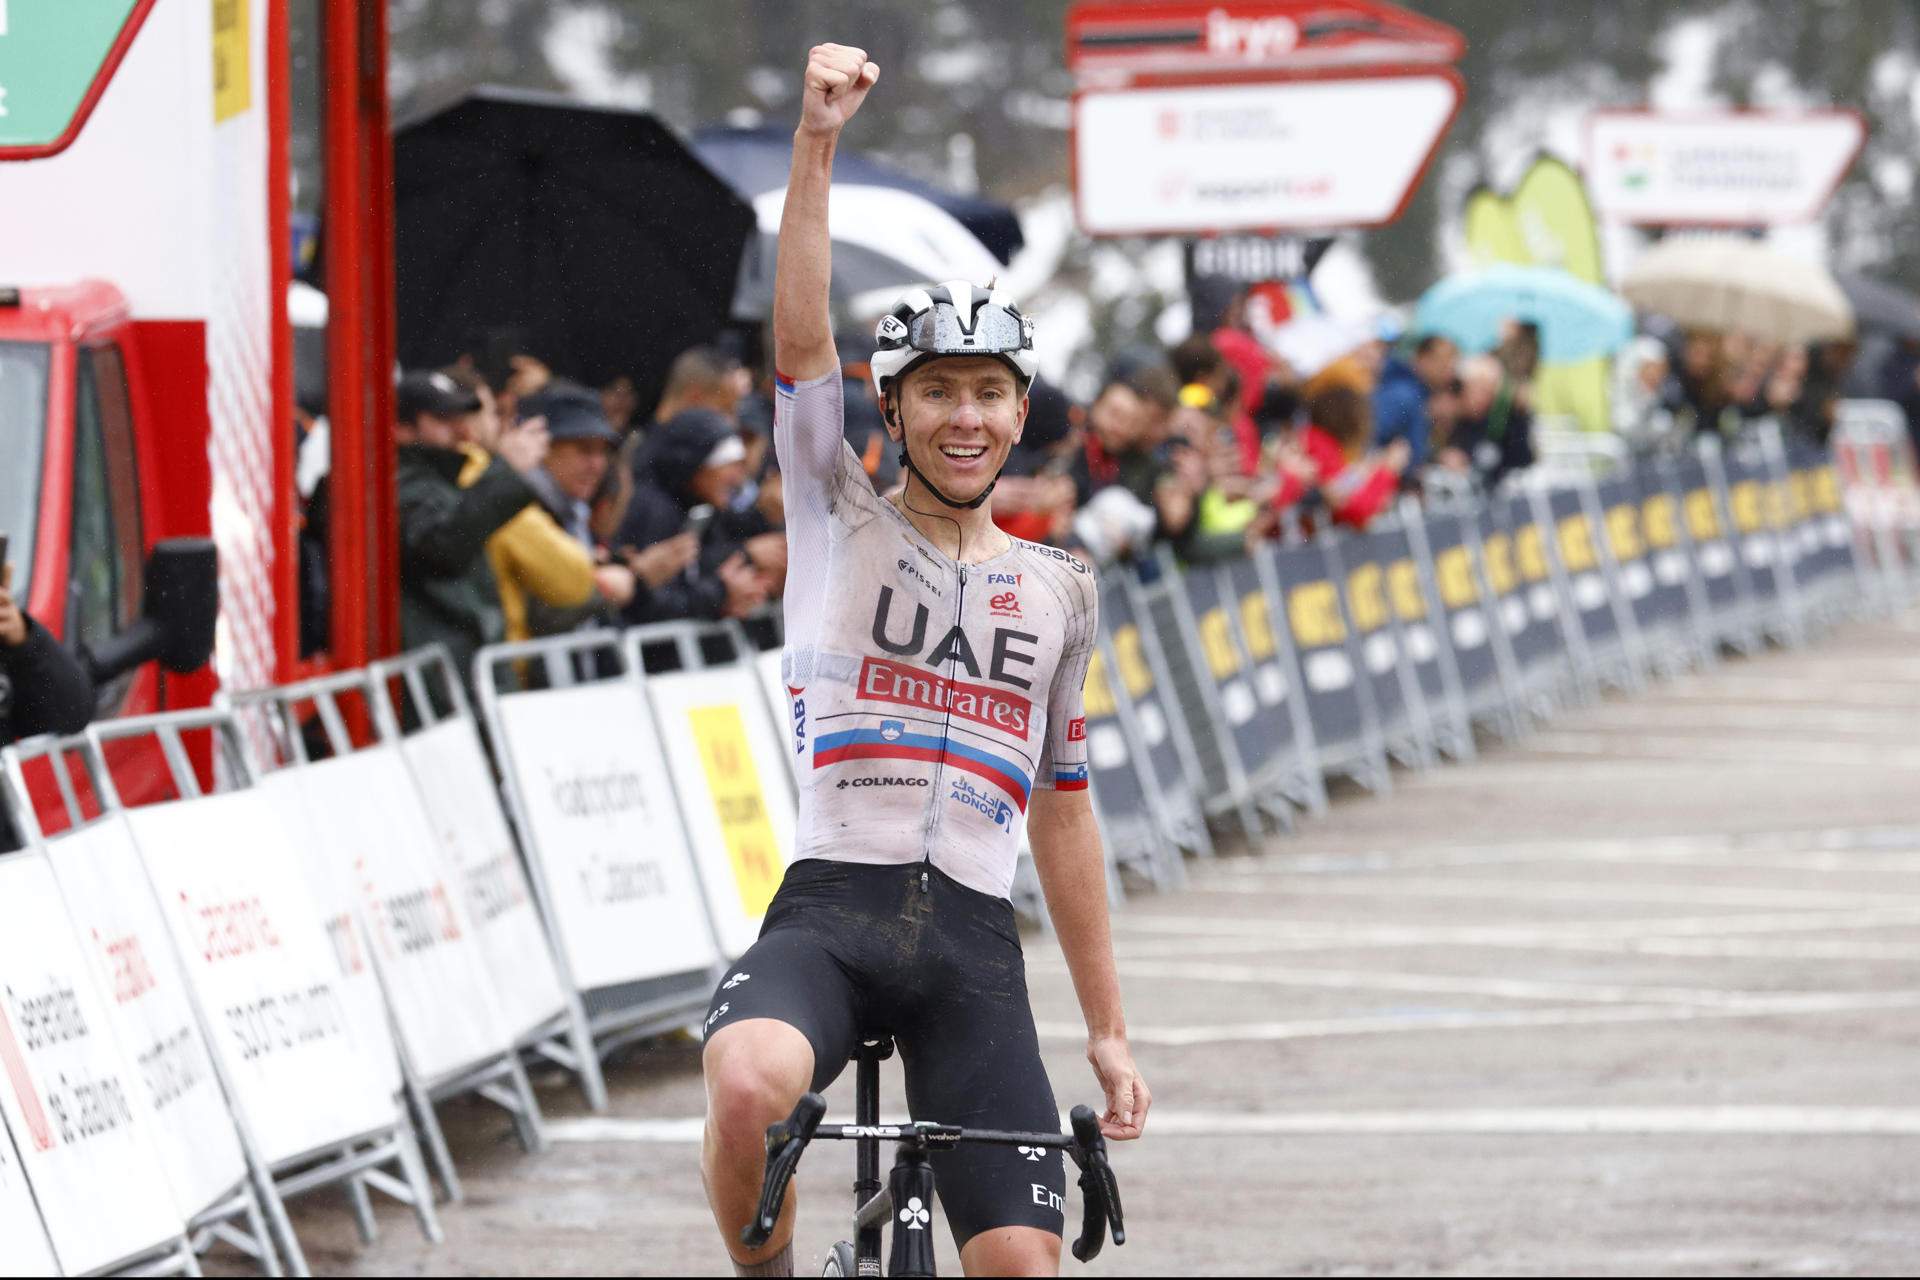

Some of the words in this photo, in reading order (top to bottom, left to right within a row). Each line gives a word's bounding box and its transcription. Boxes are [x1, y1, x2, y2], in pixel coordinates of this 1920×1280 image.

[908, 566, 941, 597] PISSEI
[872, 585, 1039, 691] UAE
[865, 664, 1024, 733] Emirates
[852, 777, 929, 788] COLNAGO
[950, 790, 995, 820] ADNOC
[928, 1133, 961, 1141] wahoo
